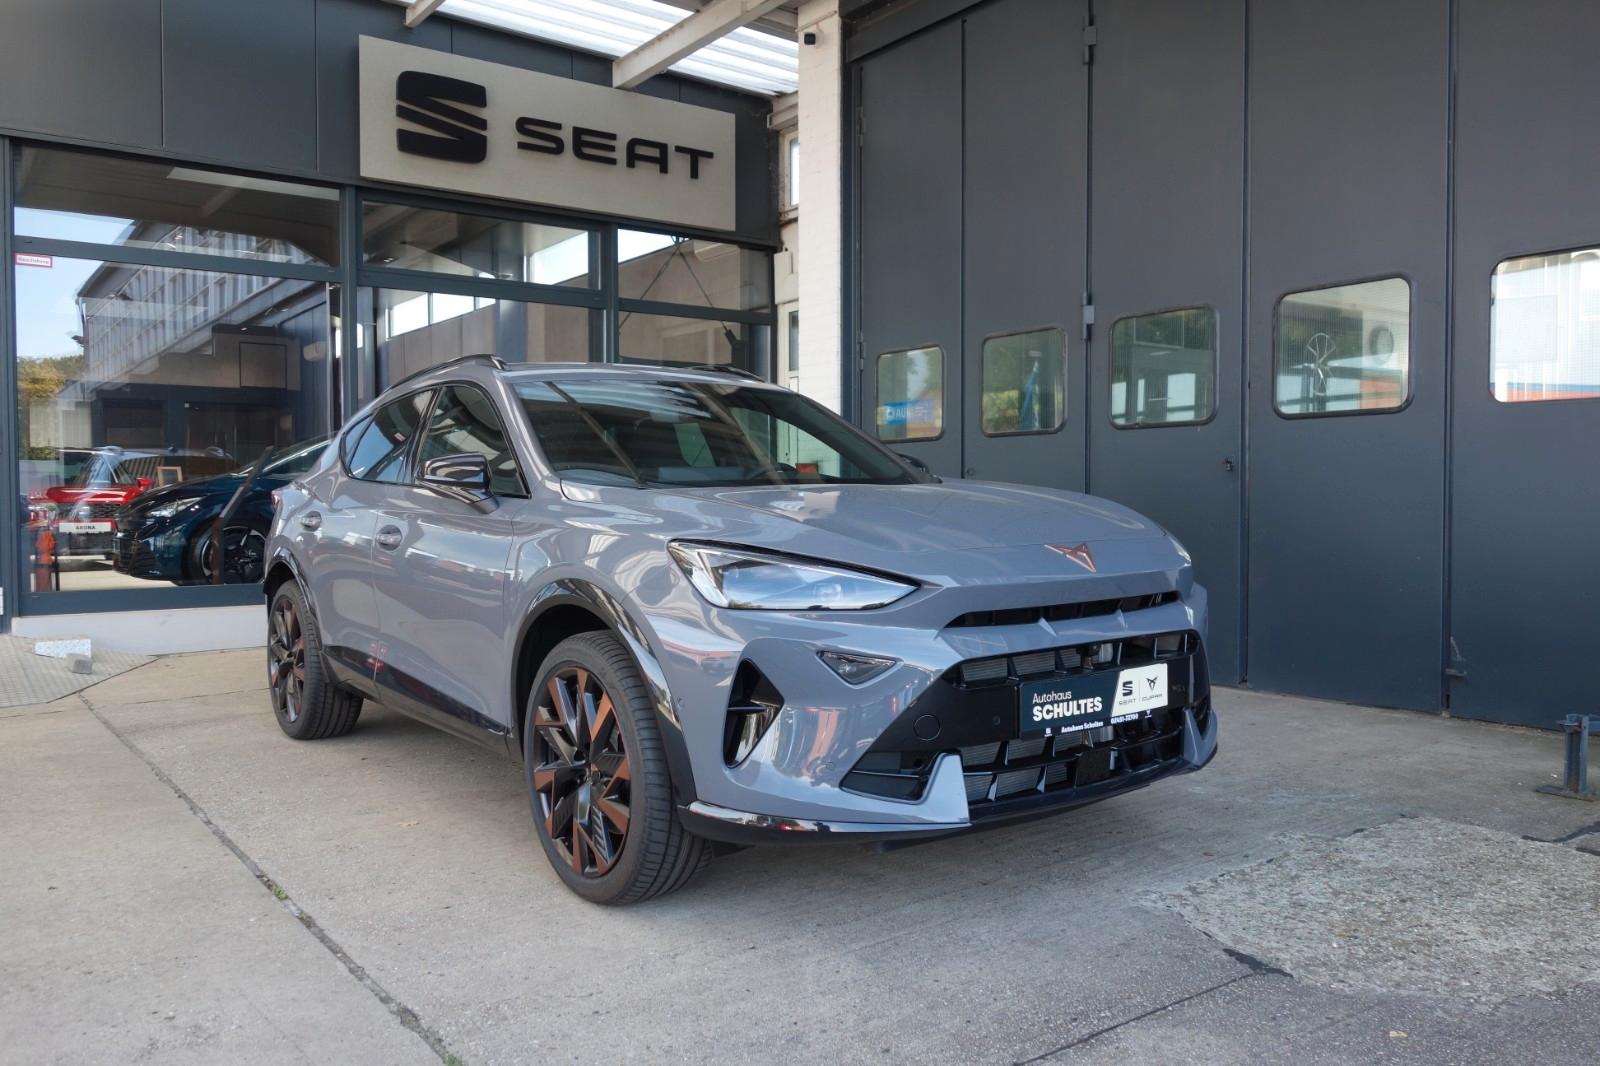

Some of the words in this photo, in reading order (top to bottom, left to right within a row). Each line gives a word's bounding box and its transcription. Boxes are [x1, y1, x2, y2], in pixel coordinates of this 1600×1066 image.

[515, 116, 714, 180] SEAT
[1032, 690, 1072, 704] Autohaus
[1032, 696, 1103, 722] SCHULTES
